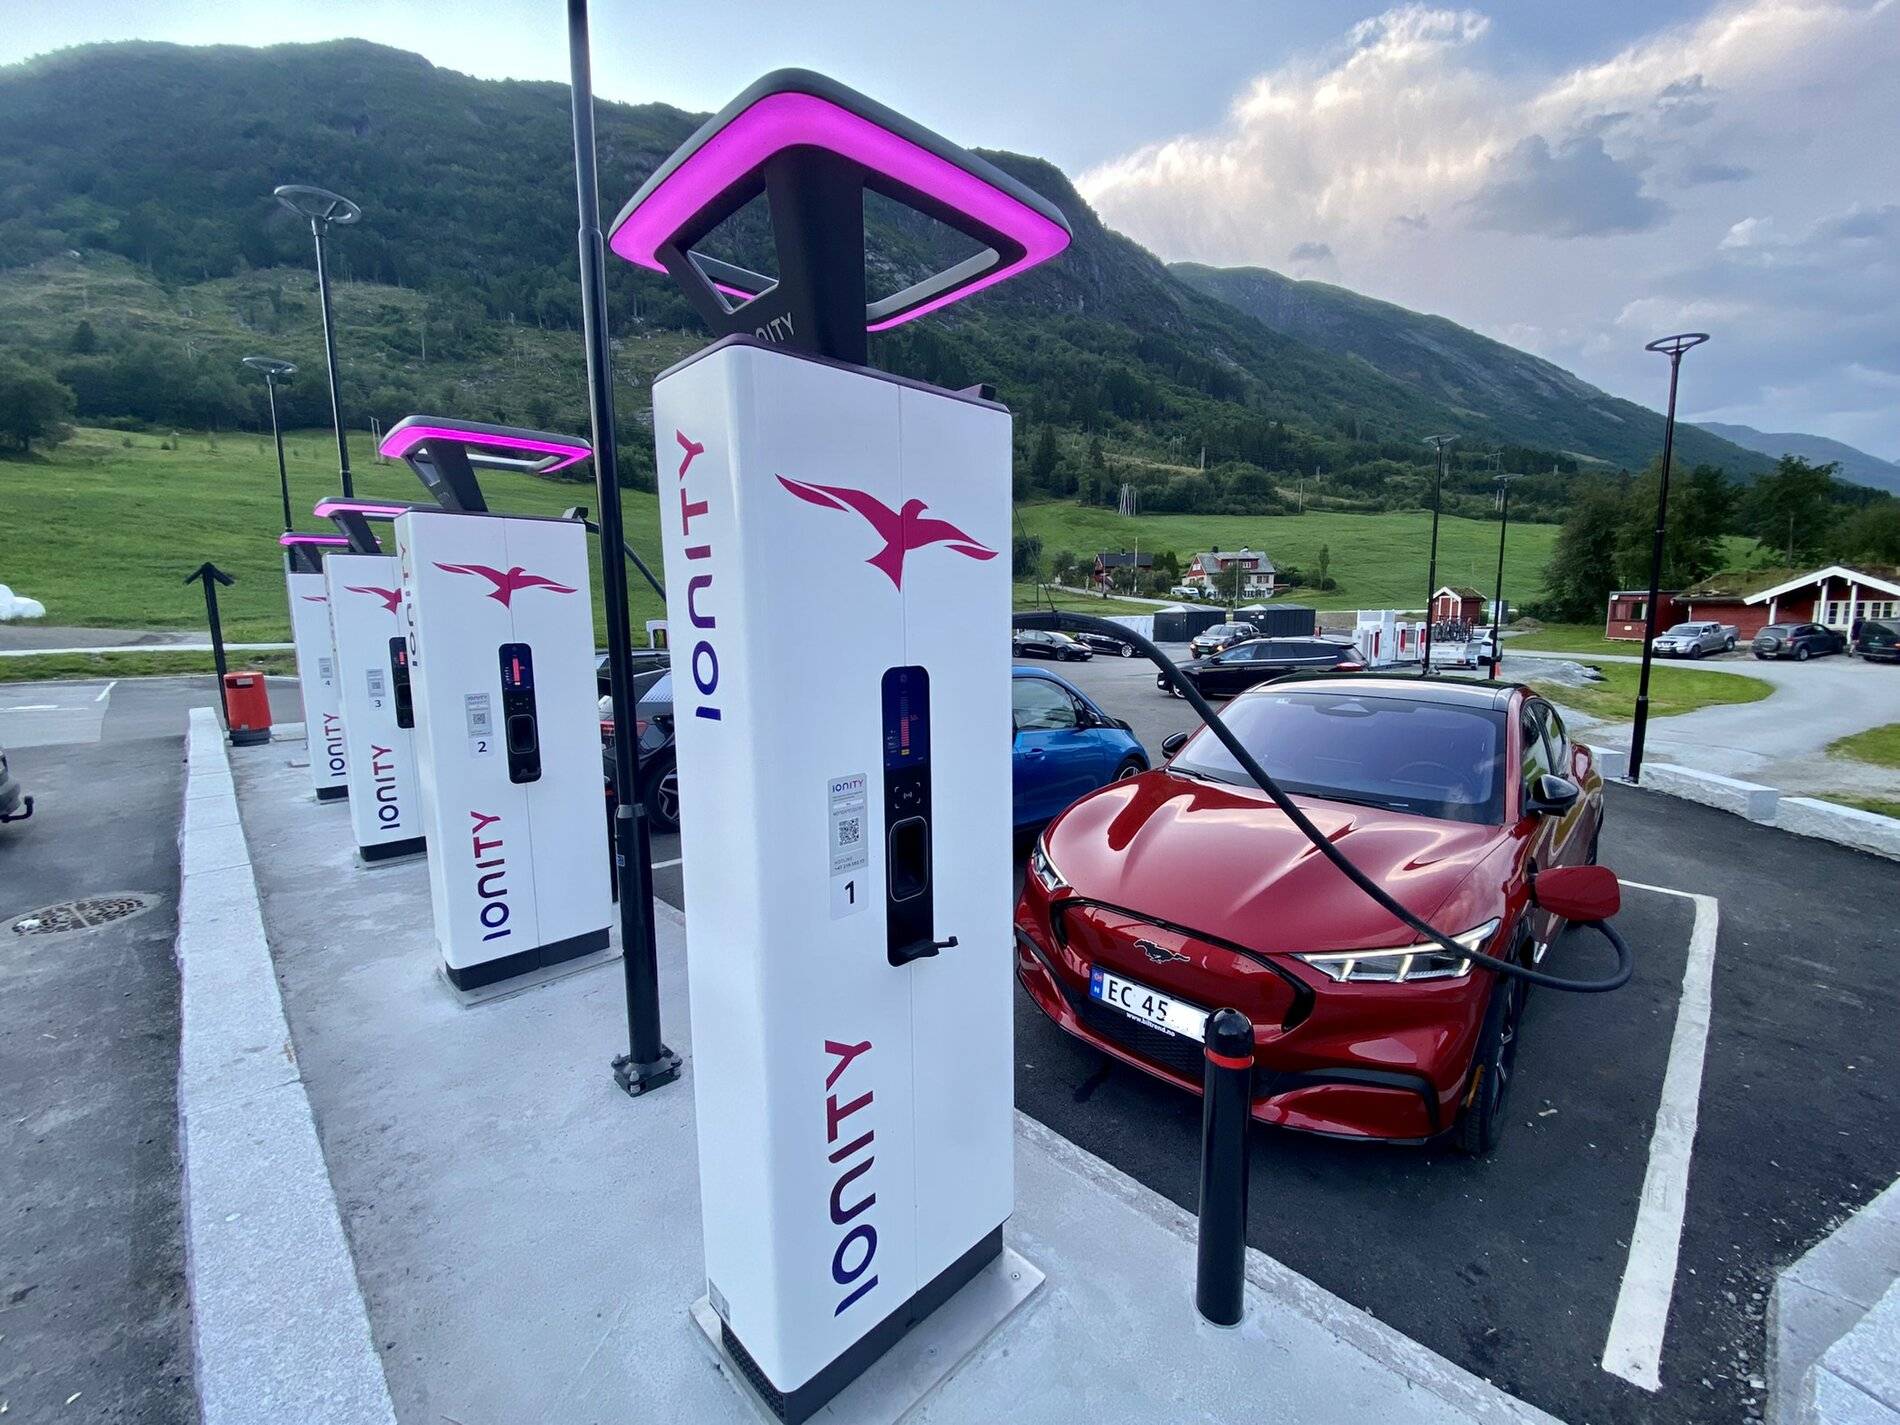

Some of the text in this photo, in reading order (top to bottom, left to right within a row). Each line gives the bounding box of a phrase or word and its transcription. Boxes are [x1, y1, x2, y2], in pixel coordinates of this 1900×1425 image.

[755, 311, 795, 343] NITY
[675, 429, 722, 722] IONITY
[374, 699, 382, 708] 3
[323, 713, 347, 777] IONITY
[477, 740, 488, 753] 2
[370, 744, 401, 831] IONITY
[832, 779, 864, 793] IONITY
[469, 810, 512, 942] IONITY
[844, 880, 855, 905] 1
[1108, 979, 1169, 1022] EC 45
[824, 1039, 879, 1318] IONITY
